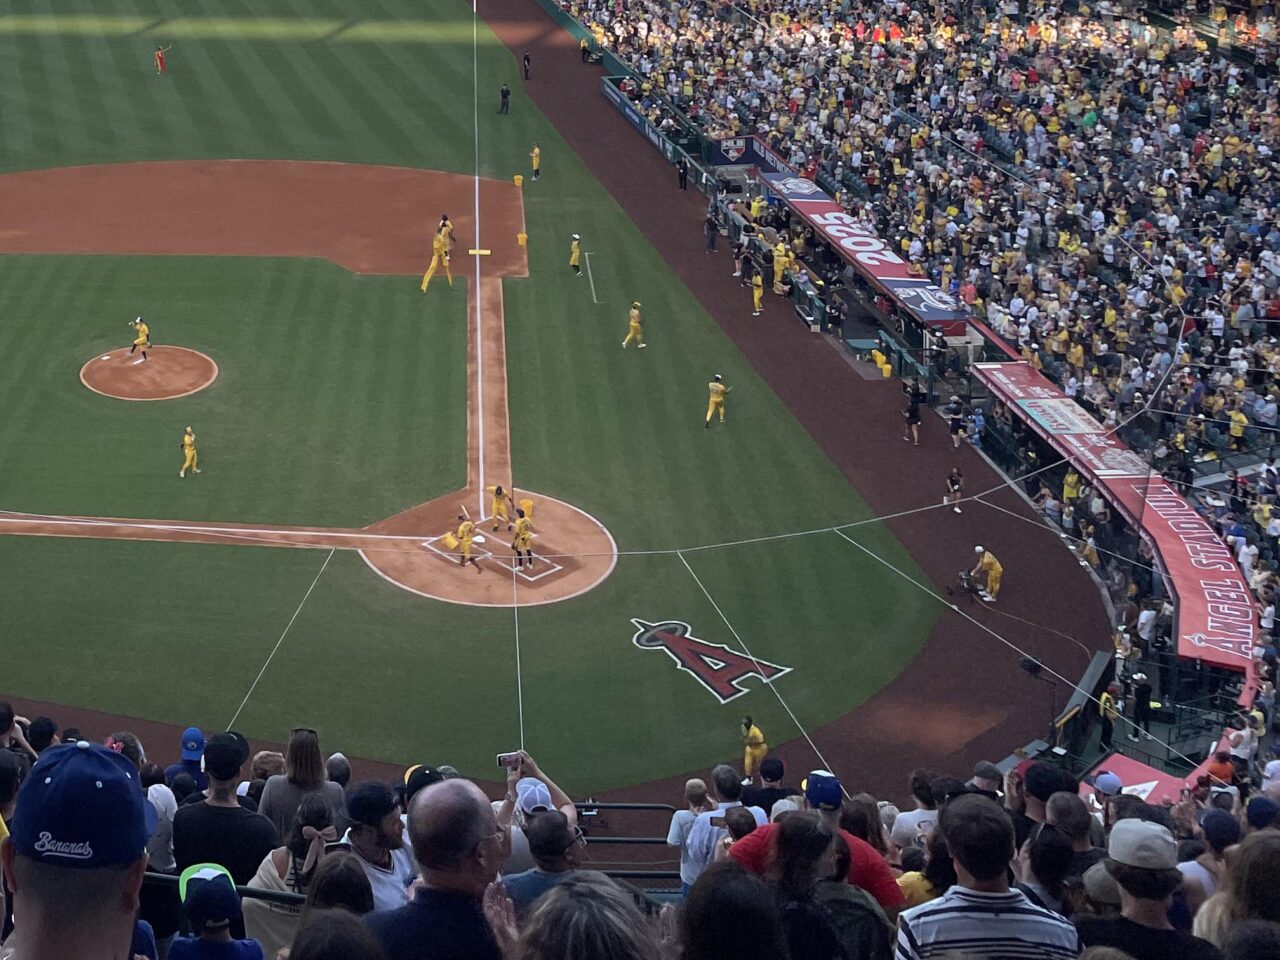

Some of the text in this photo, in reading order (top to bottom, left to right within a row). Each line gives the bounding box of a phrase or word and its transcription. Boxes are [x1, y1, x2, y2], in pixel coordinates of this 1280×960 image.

[809, 211, 907, 266] 2025
[1130, 484, 1254, 660] ANGEL STADIUM
[34, 831, 93, 859] Bananas
